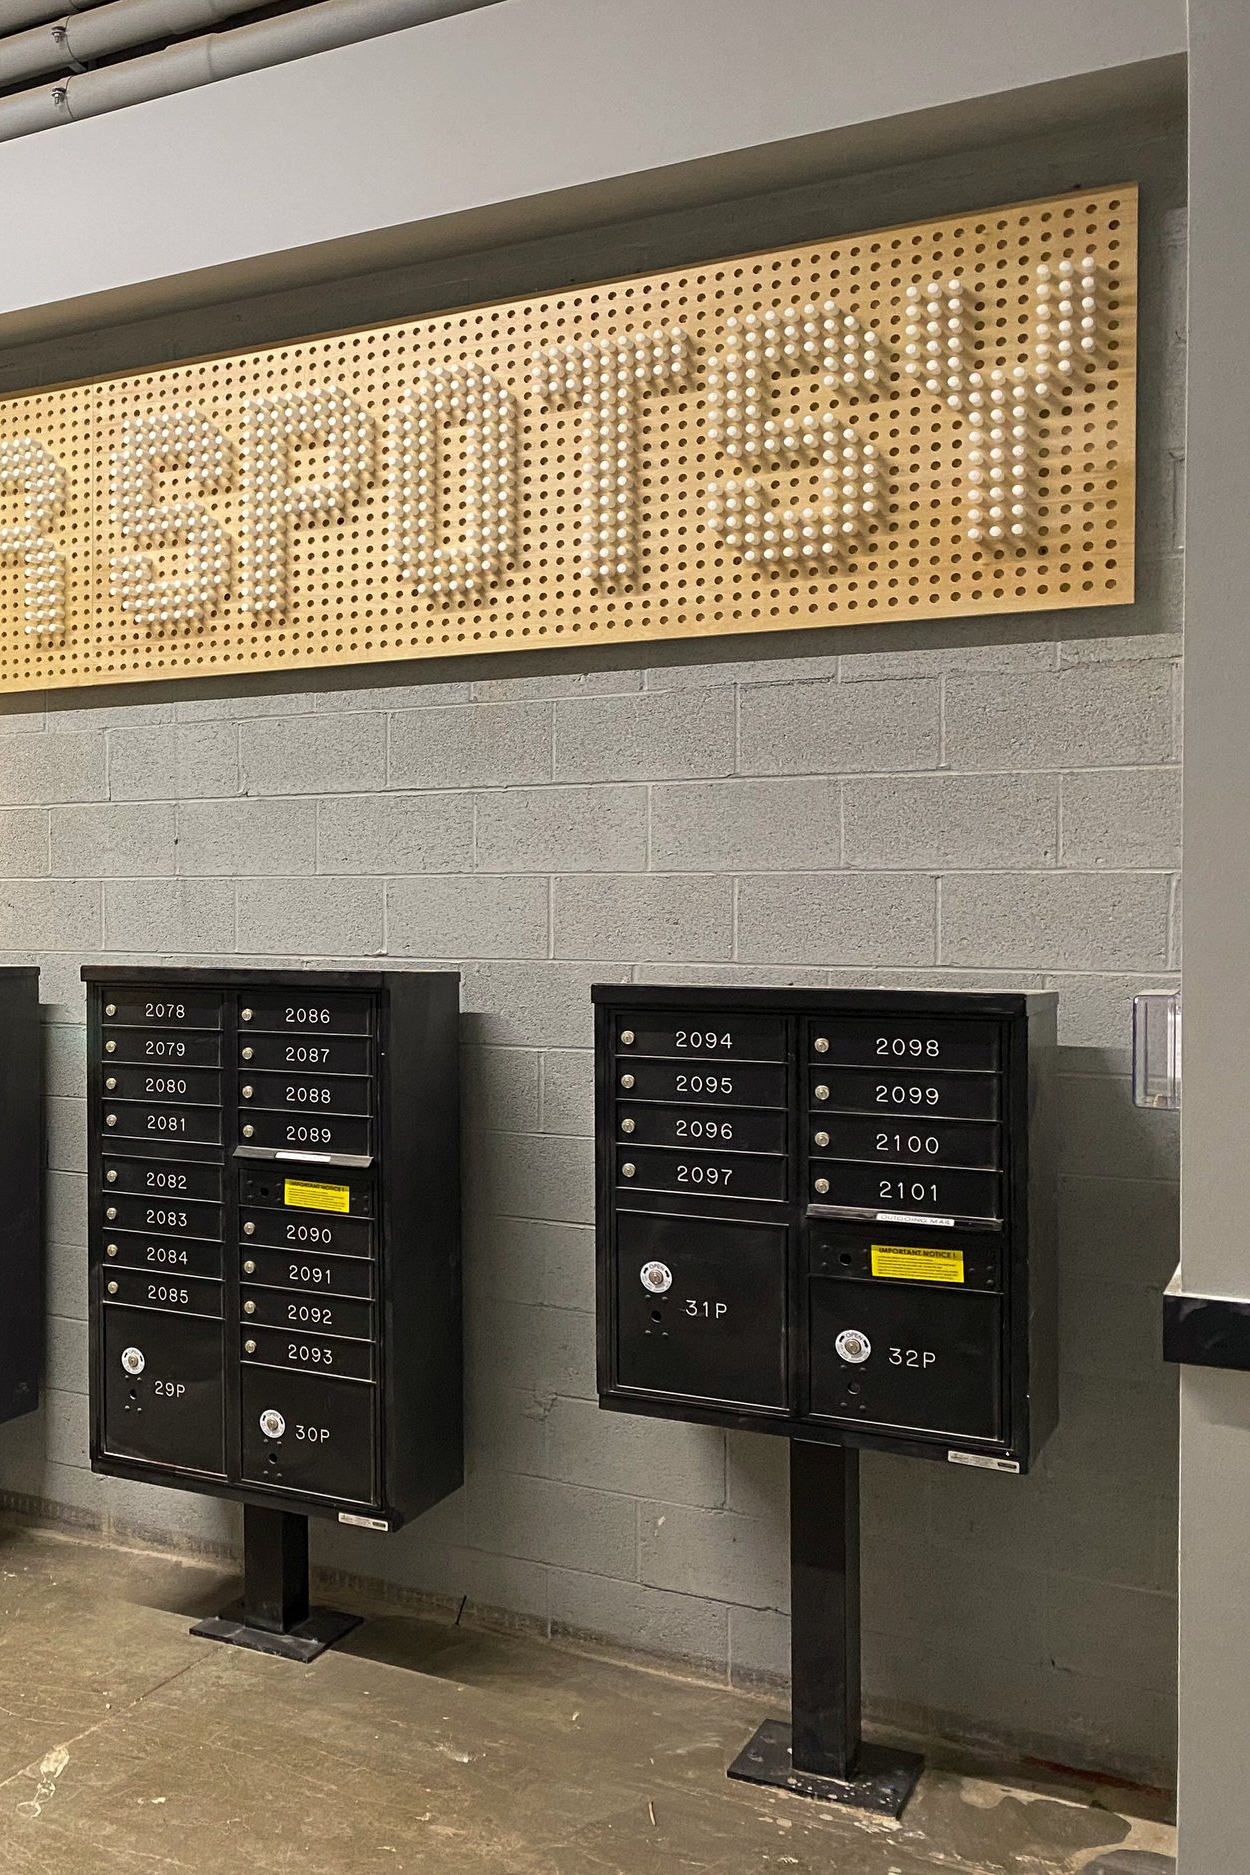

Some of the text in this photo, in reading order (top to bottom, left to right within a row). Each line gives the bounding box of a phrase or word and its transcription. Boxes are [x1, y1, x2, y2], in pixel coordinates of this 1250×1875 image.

[110, 256, 1097, 626] SPOTSY
[145, 1003, 185, 1019] 2078
[285, 1007, 330, 1024] 2086
[145, 1040, 185, 1057] 2079
[676, 1031, 733, 1049] 2094
[876, 1038, 939, 1057] 2098
[285, 1046, 330, 1063] 2087
[145, 1078, 187, 1094] 2080
[676, 1075, 733, 1094] 2095
[286, 1086, 331, 1104] 2088
[876, 1085, 939, 1105] 2099
[147, 1115, 185, 1132] 2081
[676, 1120, 733, 1140] 2096
[286, 1126, 331, 1143] 2089
[876, 1133, 939, 1154] 2100
[146, 1172, 187, 1190] 2082
[677, 1165, 733, 1185] 2097
[879, 1181, 937, 1202] 2101
[146, 1209, 187, 1227] 2083
[286, 1224, 332, 1244] 2090
[147, 1247, 188, 1265] 2084
[878, 1247, 921, 1256] IMPORTANT
[923, 1250, 951, 1258] NOTICE
[289, 1264, 330, 1284] 2091
[148, 1285, 189, 1304] 2085
[288, 1304, 332, 1325] 2092
[685, 1299, 727, 1319] 31P
[288, 1344, 333, 1365] 2093
[888, 1347, 936, 1368] 32P
[155, 1380, 186, 1398] 29P
[295, 1424, 330, 1443] 30P
